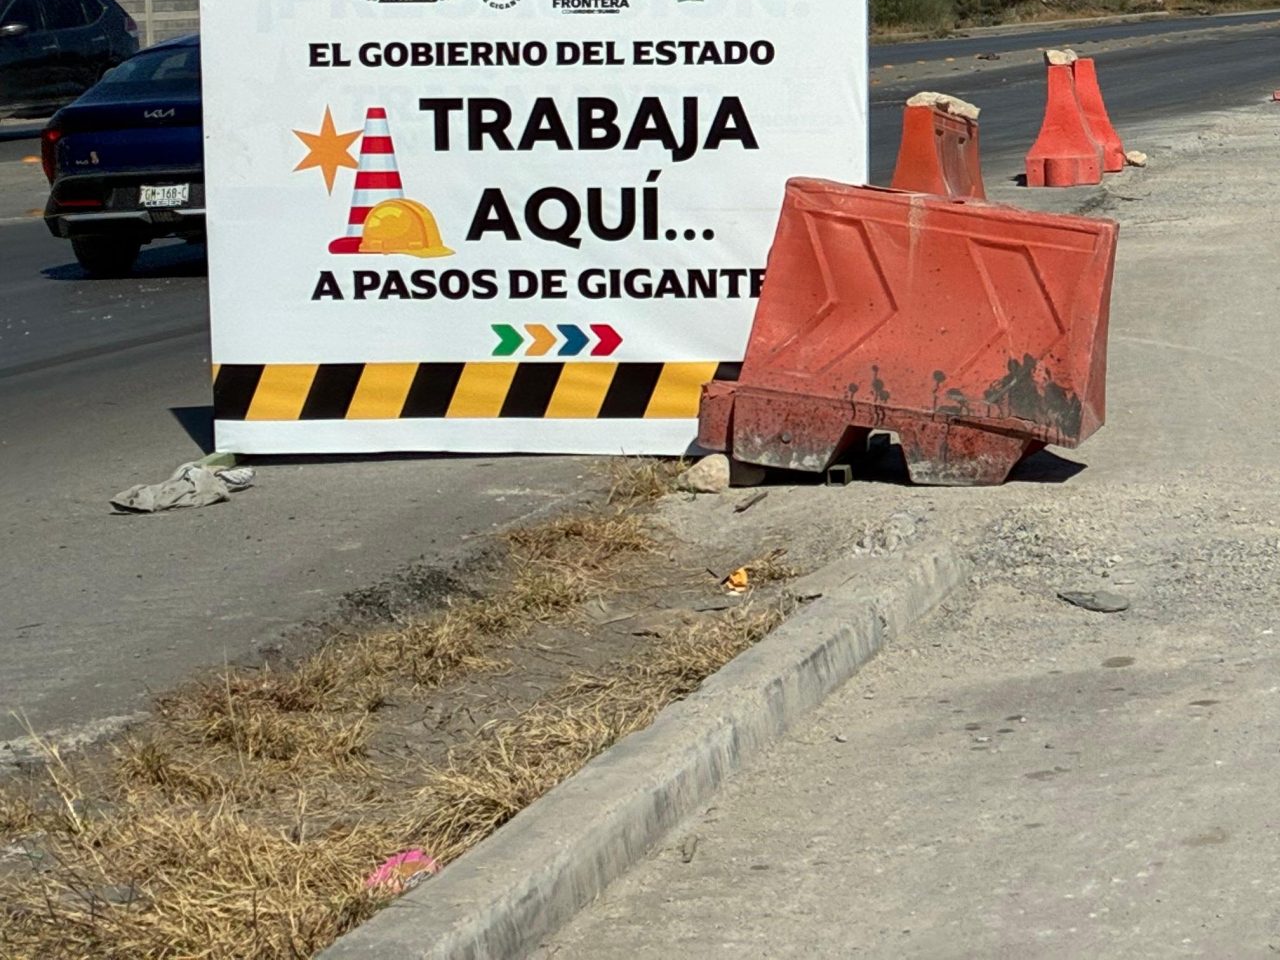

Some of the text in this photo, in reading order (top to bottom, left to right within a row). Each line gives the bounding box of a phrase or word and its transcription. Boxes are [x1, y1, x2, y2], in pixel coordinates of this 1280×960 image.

[309, 39, 775, 68] EL GOBIERNO DEL ESTADO
[418, 97, 759, 163] TRABAJA
[465, 169, 715, 250] AQUÍ...
[311, 269, 344, 301] A
[352, 269, 499, 301] PASOS
[508, 269, 568, 301] DE
